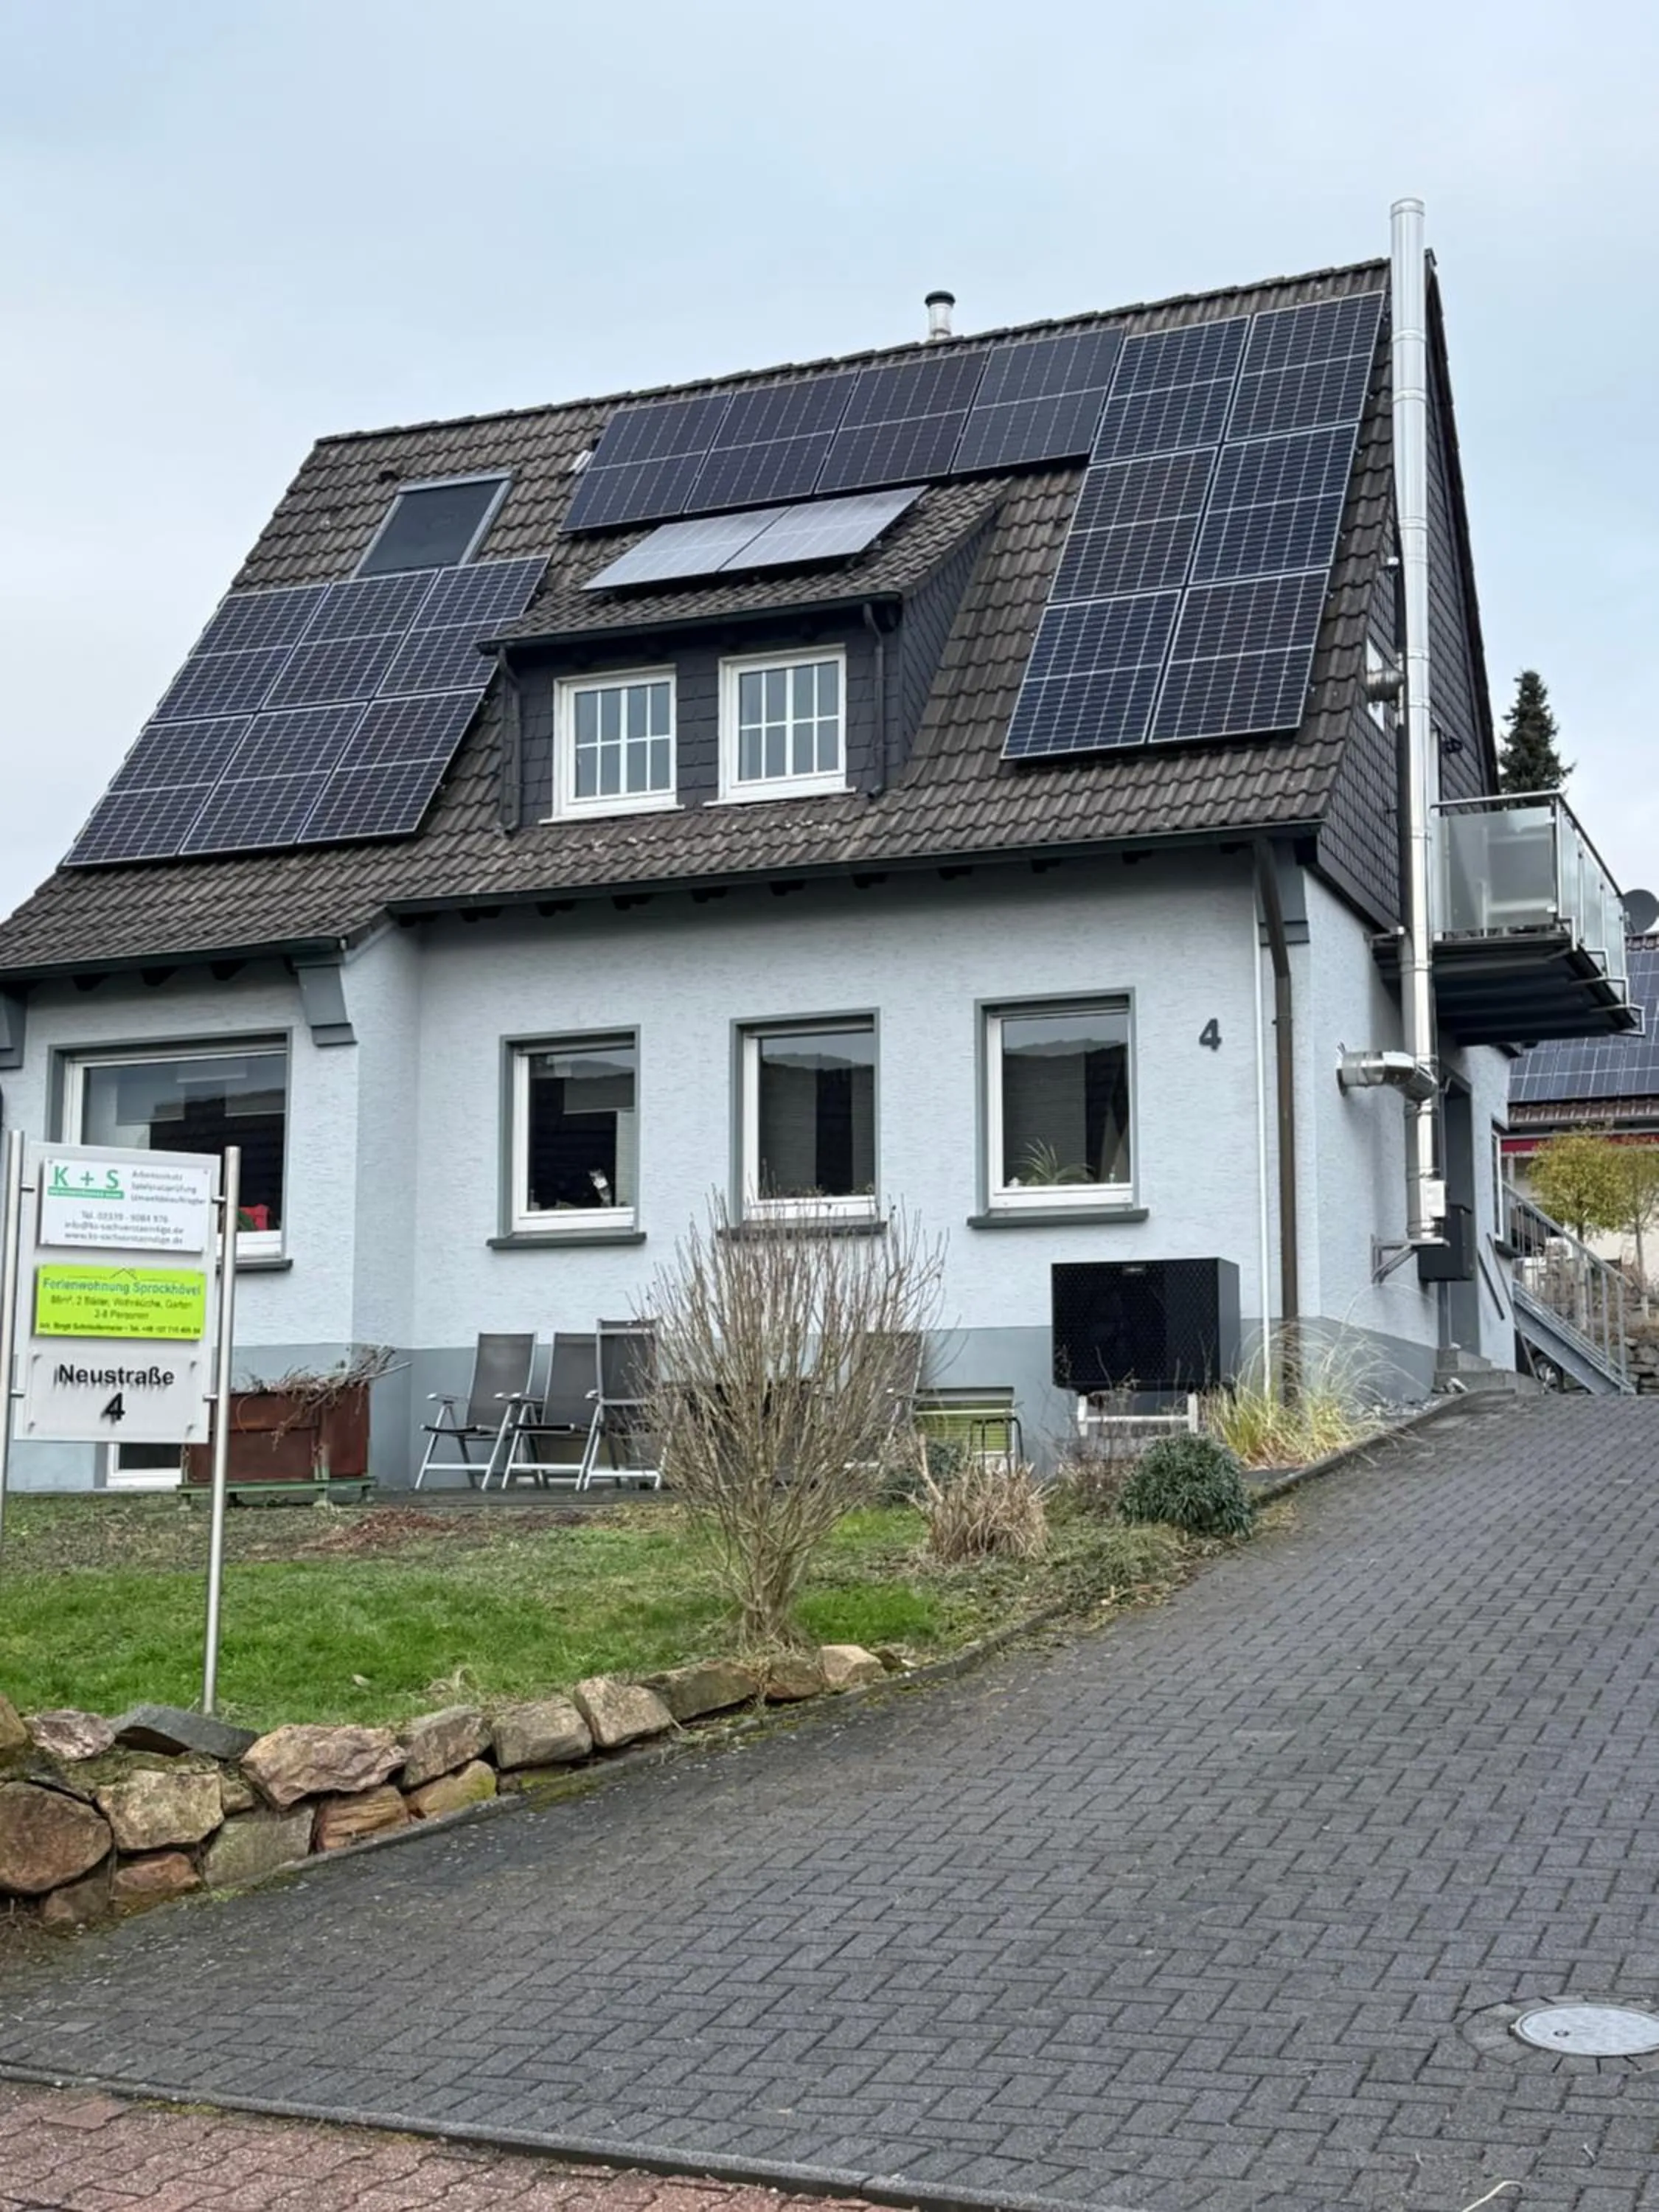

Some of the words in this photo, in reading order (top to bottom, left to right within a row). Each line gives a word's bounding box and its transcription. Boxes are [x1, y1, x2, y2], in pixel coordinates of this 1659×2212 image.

[1198, 1018, 1222, 1052] 4
[43, 1277, 130, 1295] Ferienwohnung
[133, 1281, 201, 1296] Sprockhövel
[58, 1363, 175, 1385] Neustraße
[102, 1391, 125, 1422] 4
